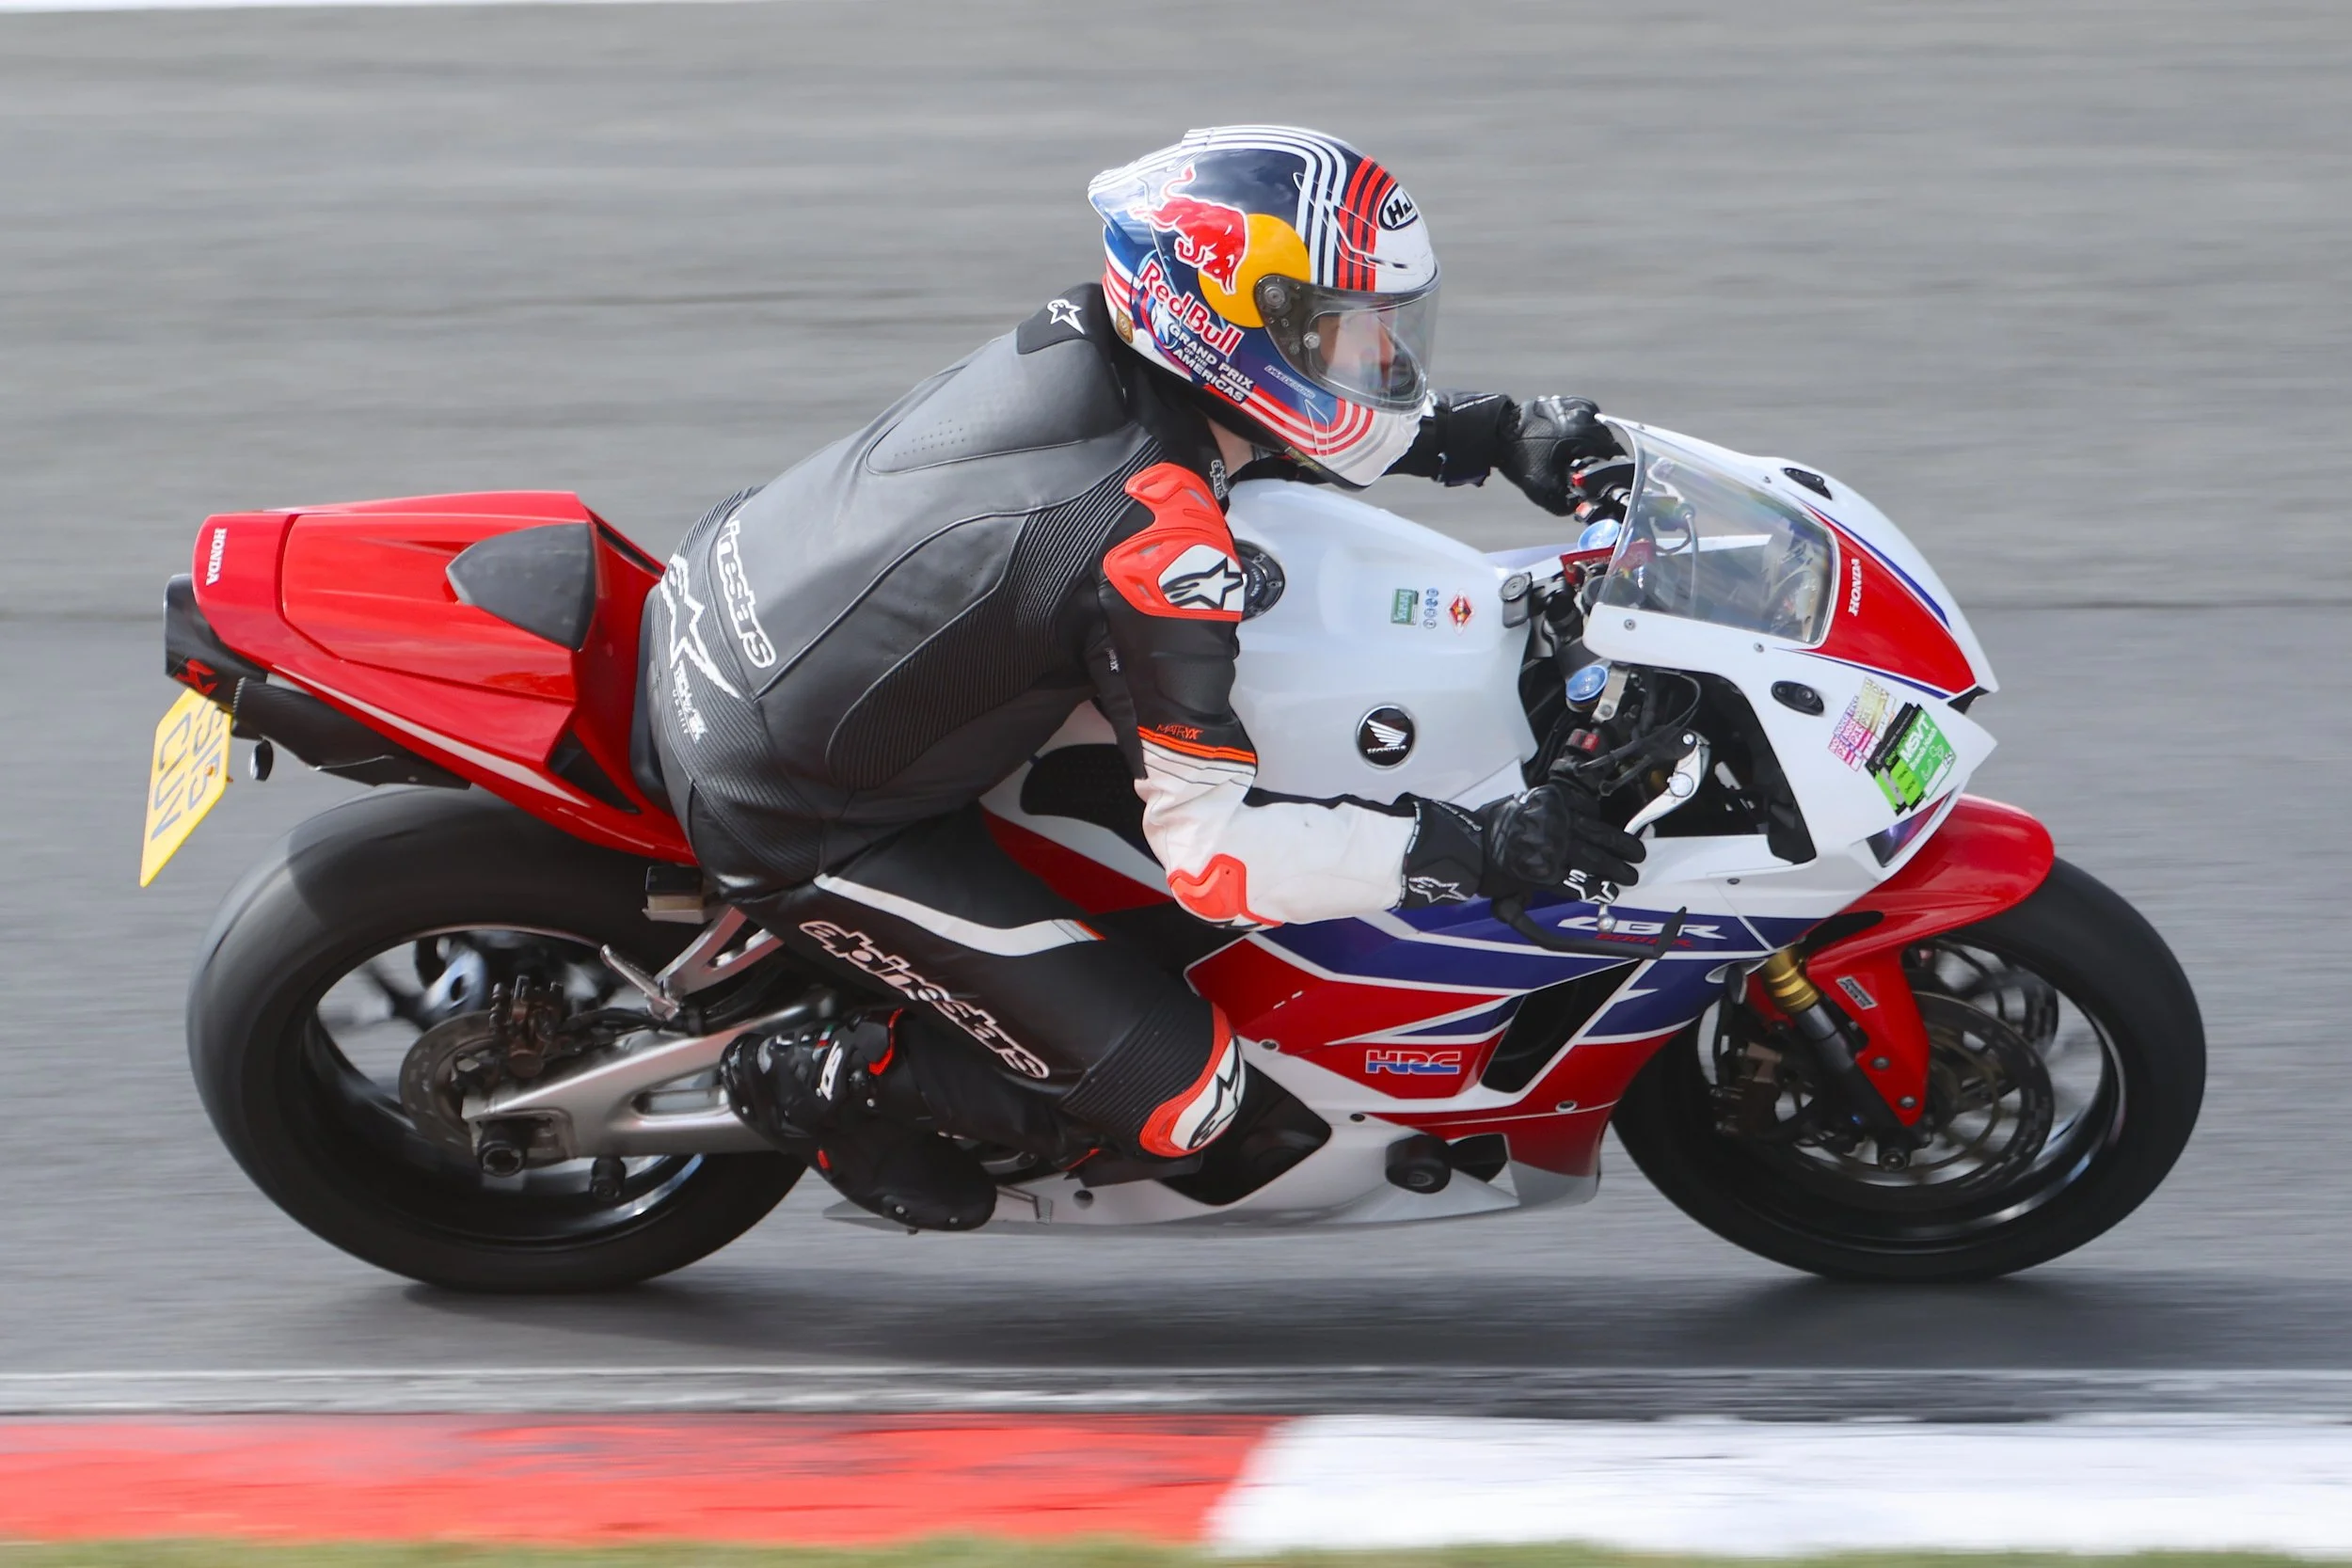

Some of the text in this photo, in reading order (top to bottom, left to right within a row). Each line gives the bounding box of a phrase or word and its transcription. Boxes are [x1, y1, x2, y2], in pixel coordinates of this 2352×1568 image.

[1386, 191, 1414, 226] HJ
[1139, 259, 1246, 358] Red Bull
[1169, 324, 1217, 366] GRAND
[1218, 362, 1254, 389] PRIX
[1173, 350, 1245, 403] AMERICAS
[206, 527, 228, 586] HONDA
[717, 519, 776, 669] inestars
[1848, 558, 1863, 617] HONDA
[191, 700, 224, 811] S15
[1156, 723, 1203, 740] MATRYX
[1557, 916, 1727, 940] CBR
[799, 921, 1050, 1079] alpinestars
[1365, 1050, 1462, 1075] HRC
